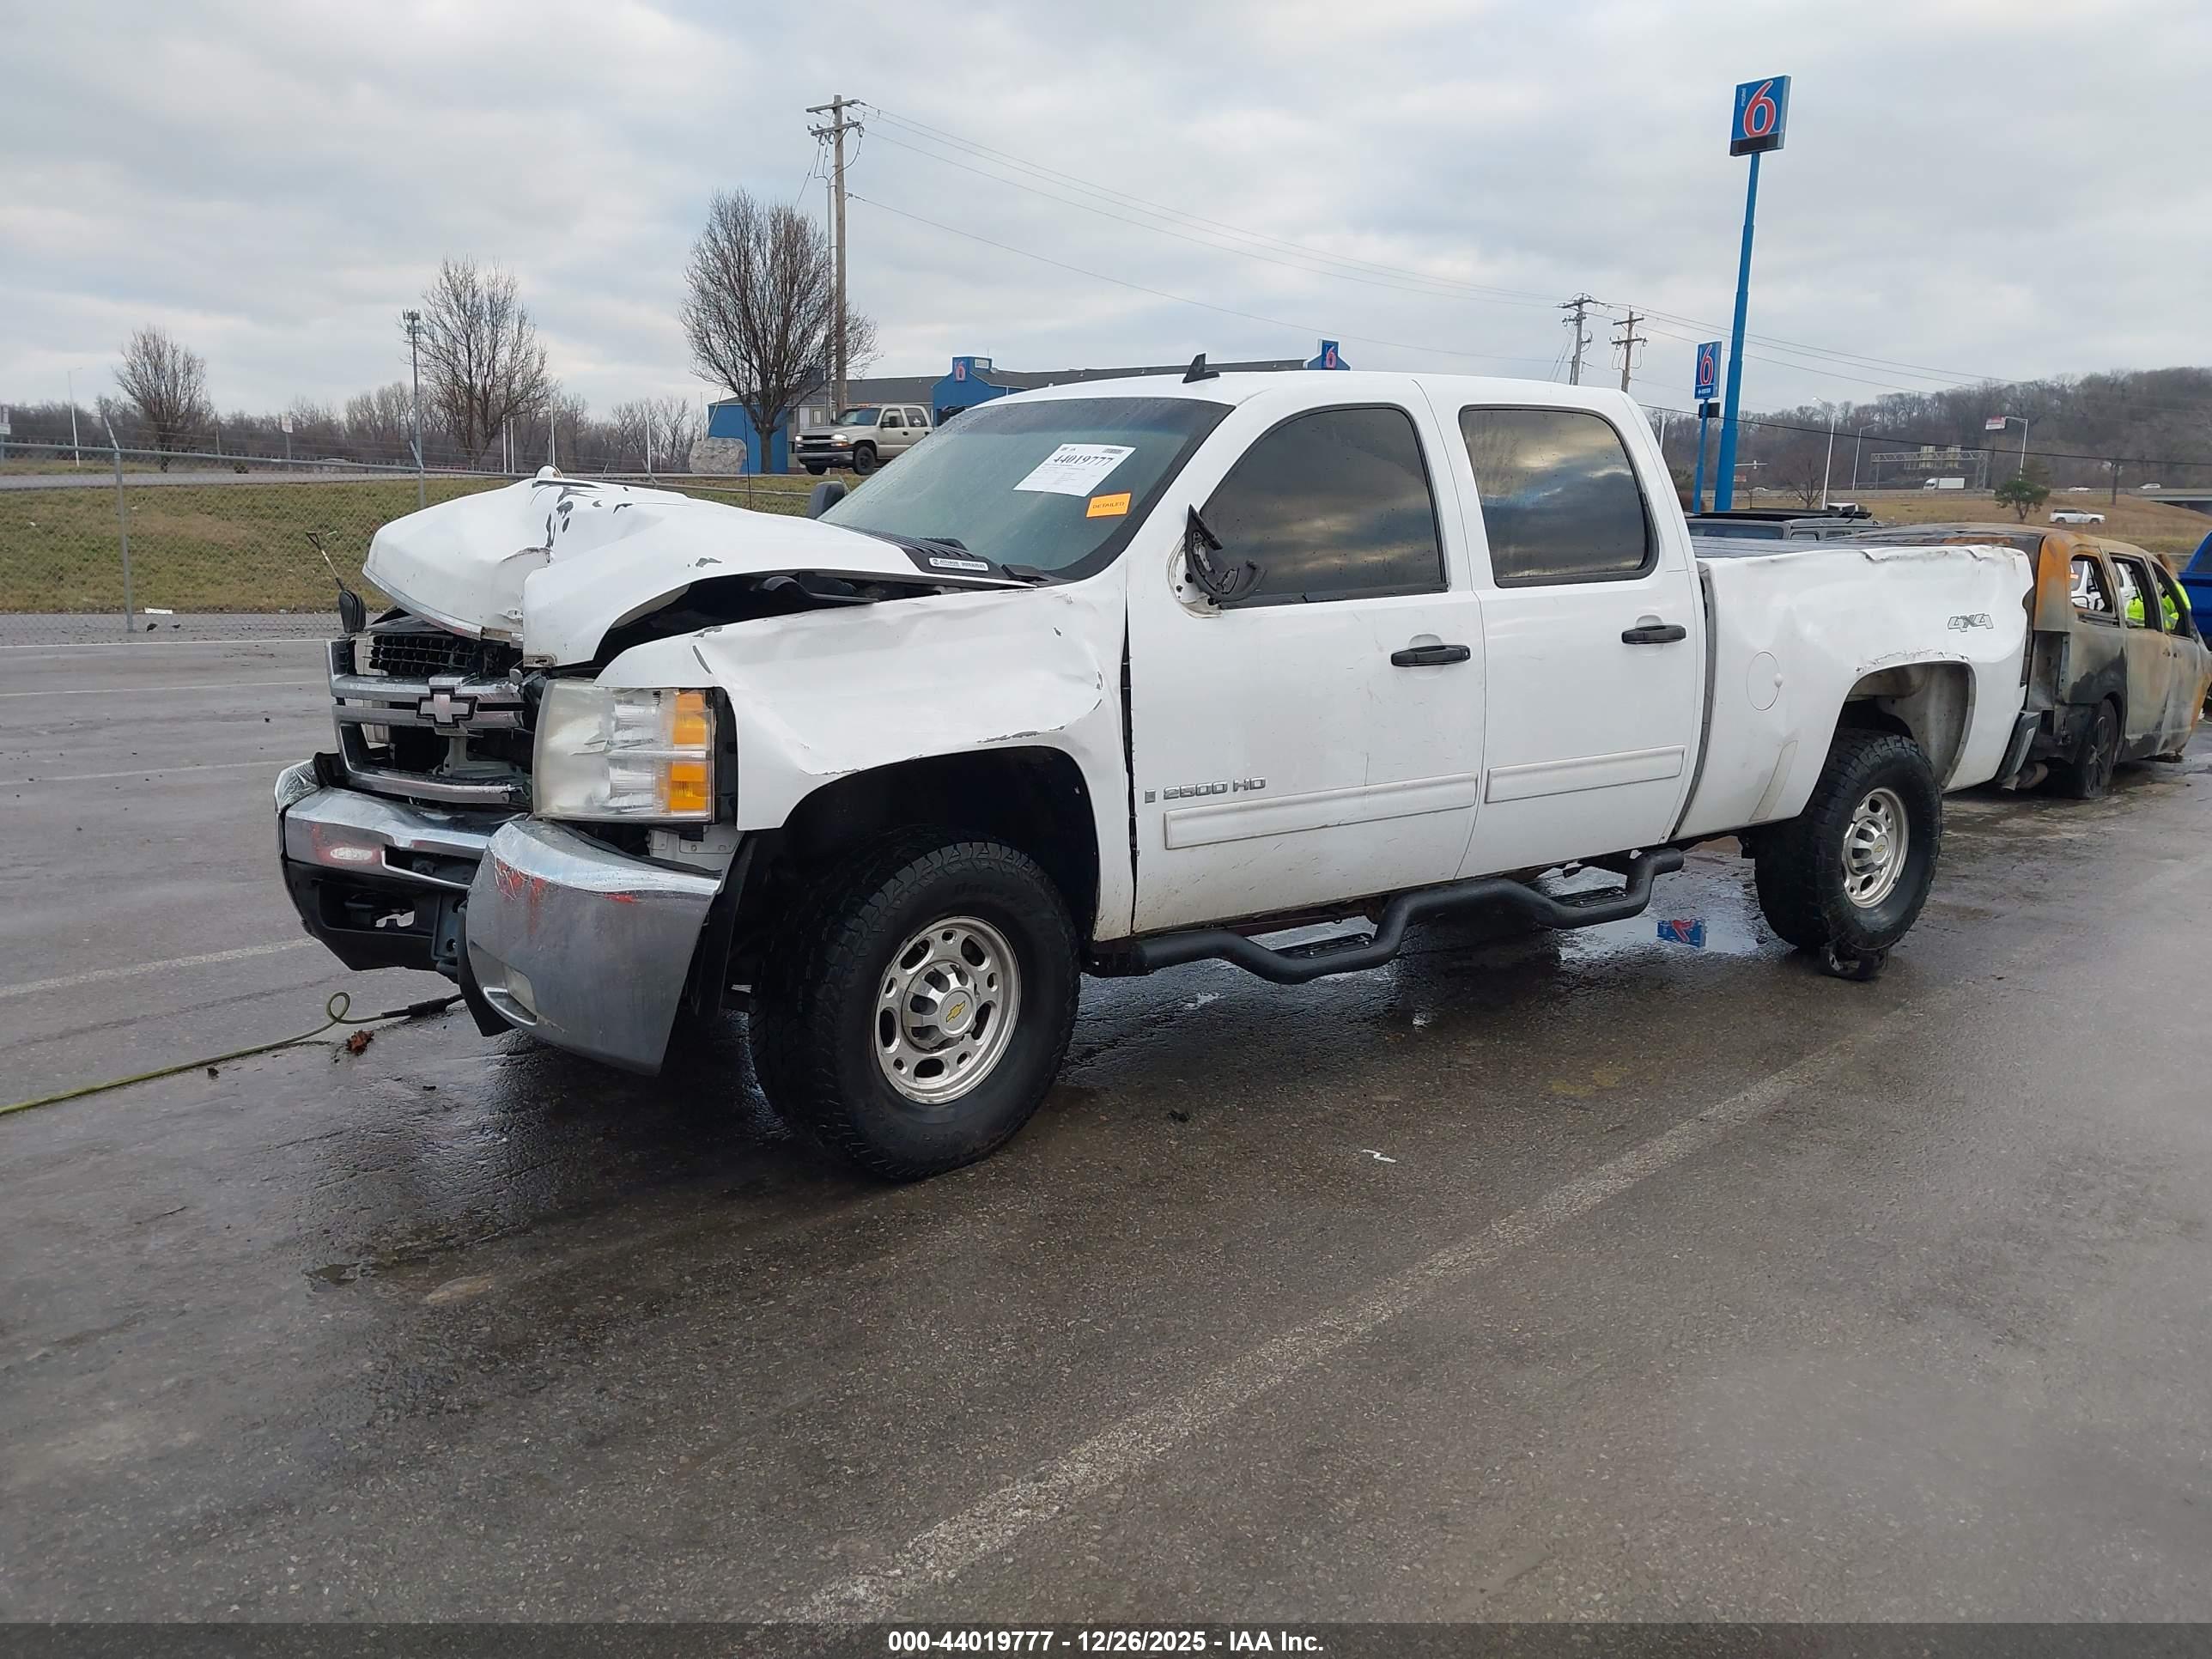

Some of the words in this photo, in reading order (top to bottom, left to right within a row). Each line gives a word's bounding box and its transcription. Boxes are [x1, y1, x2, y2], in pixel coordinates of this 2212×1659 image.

[1743, 80, 1776, 137] 6
[1700, 343, 1714, 385] 6
[1054, 454, 1115, 466] 44019777
[1163, 781, 1228, 799] 2500
[1233, 776, 1267, 793] HD
